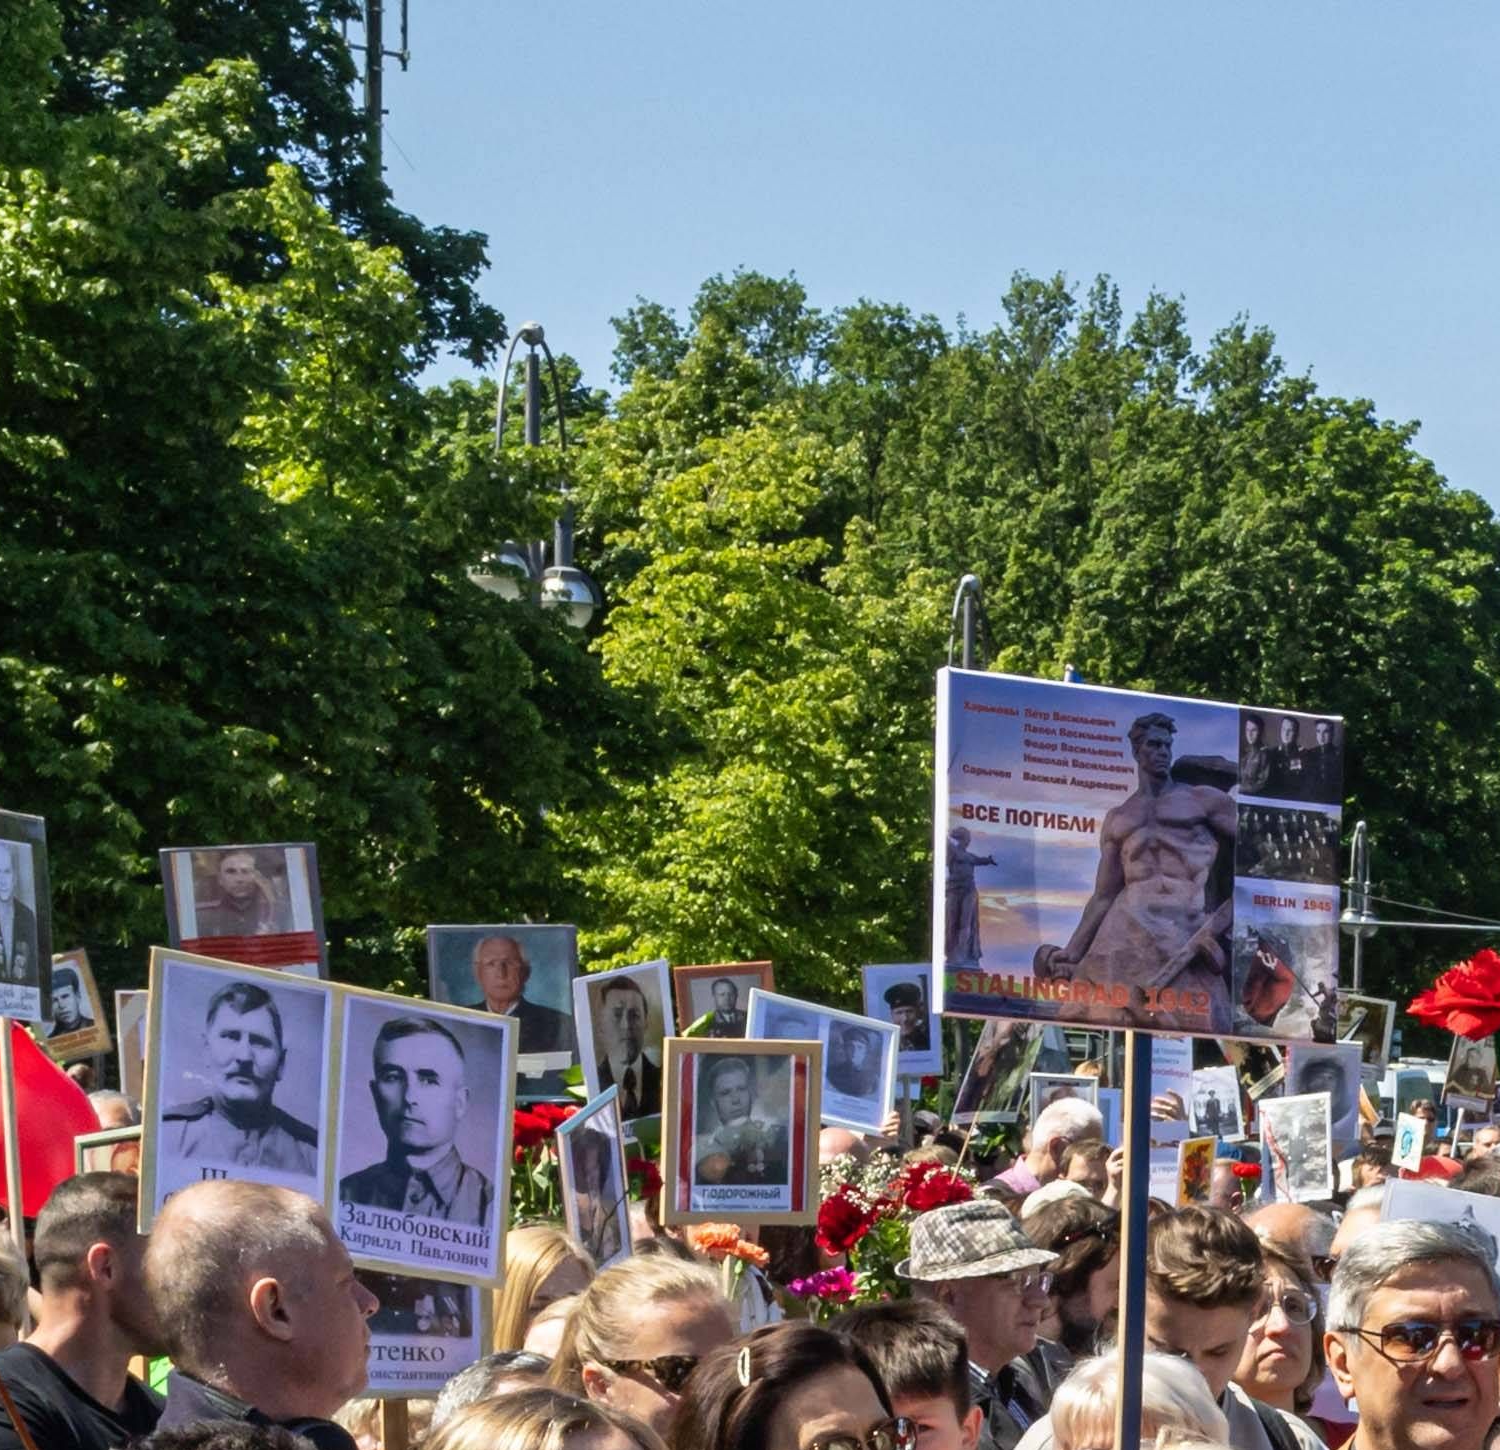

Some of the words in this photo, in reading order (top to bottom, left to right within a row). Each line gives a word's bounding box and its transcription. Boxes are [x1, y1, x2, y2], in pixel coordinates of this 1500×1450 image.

[962, 803, 1001, 824] ВСЕ
[1005, 808, 1096, 834] ПОГИБЛИ
[1252, 894, 1297, 910] BERLIN
[1302, 899, 1333, 913] 1945
[954, 971, 1130, 1008] STALINGRAD
[1143, 985, 1211, 1014] 1942
[340, 1225, 401, 1252] Кирилл
[409, 1239, 489, 1269] Павлович
[342, 1201, 491, 1250] Залюбовский
